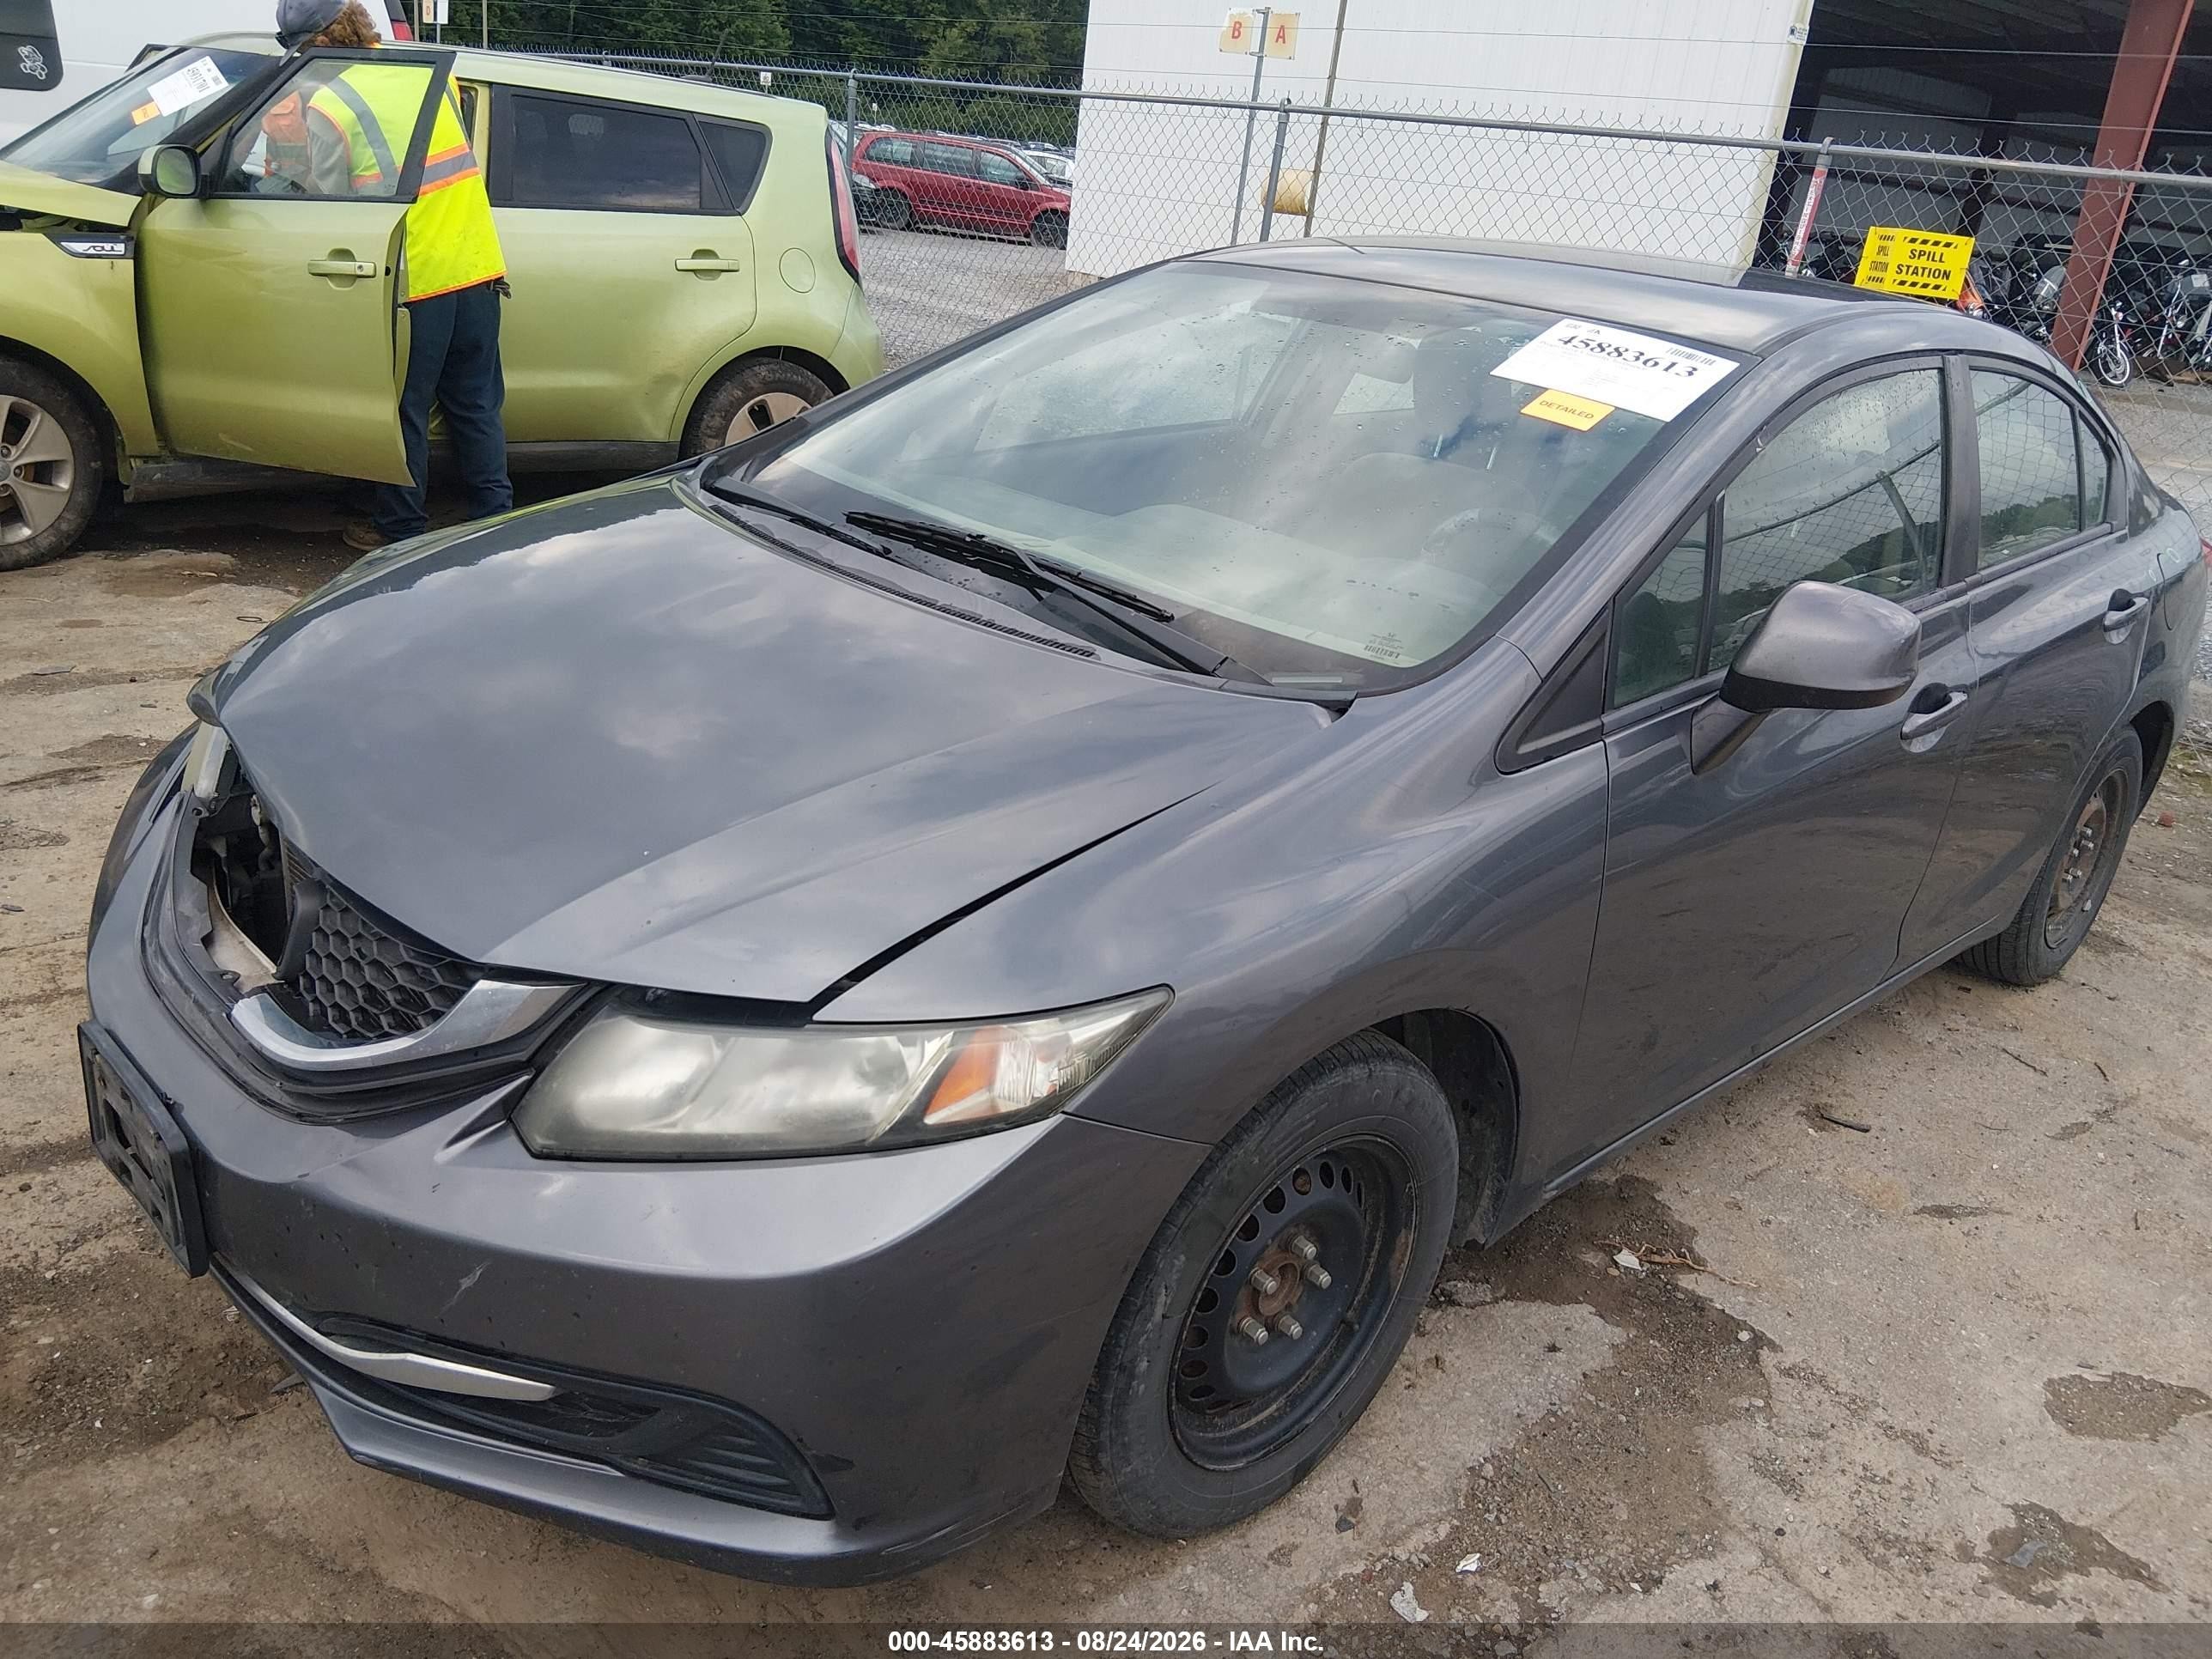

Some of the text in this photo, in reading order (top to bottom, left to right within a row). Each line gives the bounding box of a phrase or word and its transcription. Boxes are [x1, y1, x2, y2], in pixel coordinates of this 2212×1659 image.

[1231, 21, 1243, 40] B
[1275, 25, 1286, 44] A
[1876, 245, 1890, 257] SPILL
[1908, 248, 1946, 264] SPILL
[1869, 260, 1890, 274] STATION
[1895, 263, 1952, 281] STATION
[1558, 335, 1698, 379] 45883613
[1540, 399, 1595, 420] DETAILED
